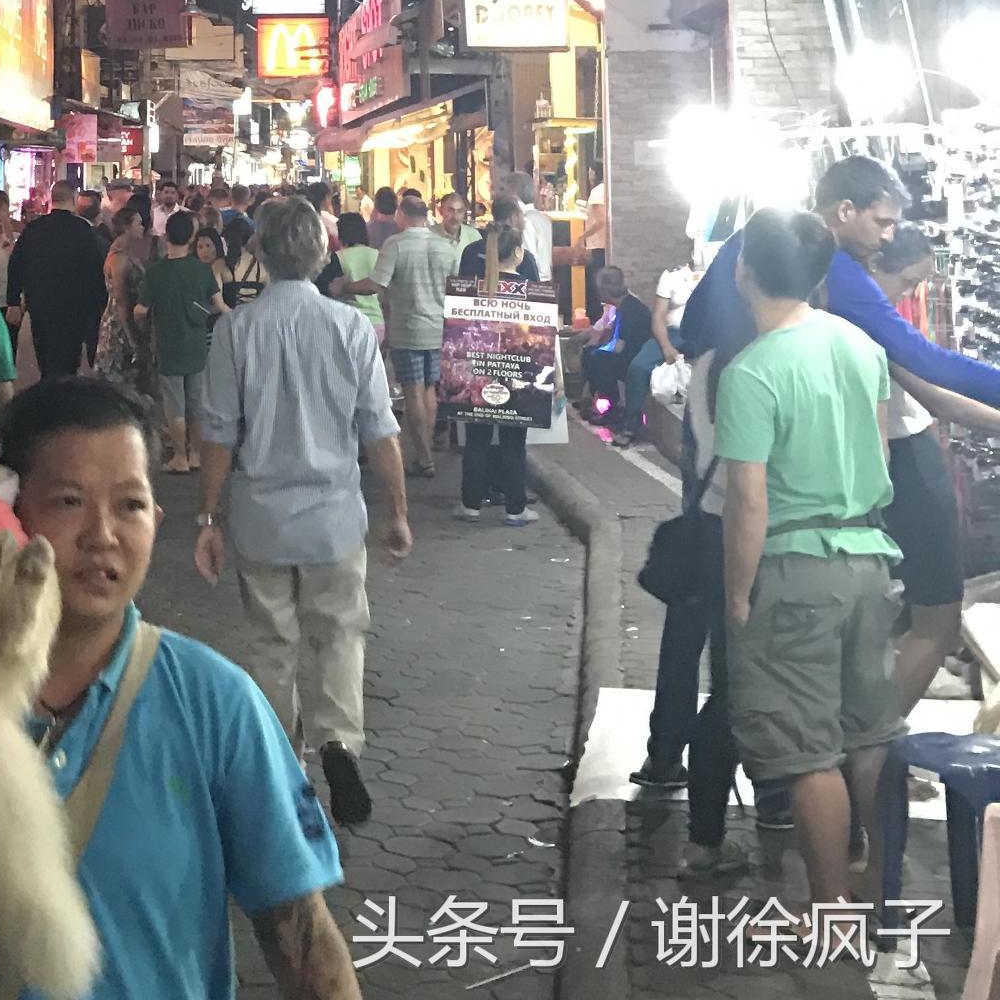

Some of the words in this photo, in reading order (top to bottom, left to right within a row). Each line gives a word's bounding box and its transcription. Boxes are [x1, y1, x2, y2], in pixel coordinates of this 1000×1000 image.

[473, 298, 498, 307] ВСЮ
[501, 300, 531, 310] НОЧЬ
[451, 307, 520, 320] БЕСПЛАТНЫЙ
[523, 313, 551, 324] ВХОД
[486, 352, 531, 363] NIGHTCLUB
[487, 361, 520, 370] PATTAYA
[473, 367, 485, 375] ON
[493, 369, 523, 378] FLOORS
